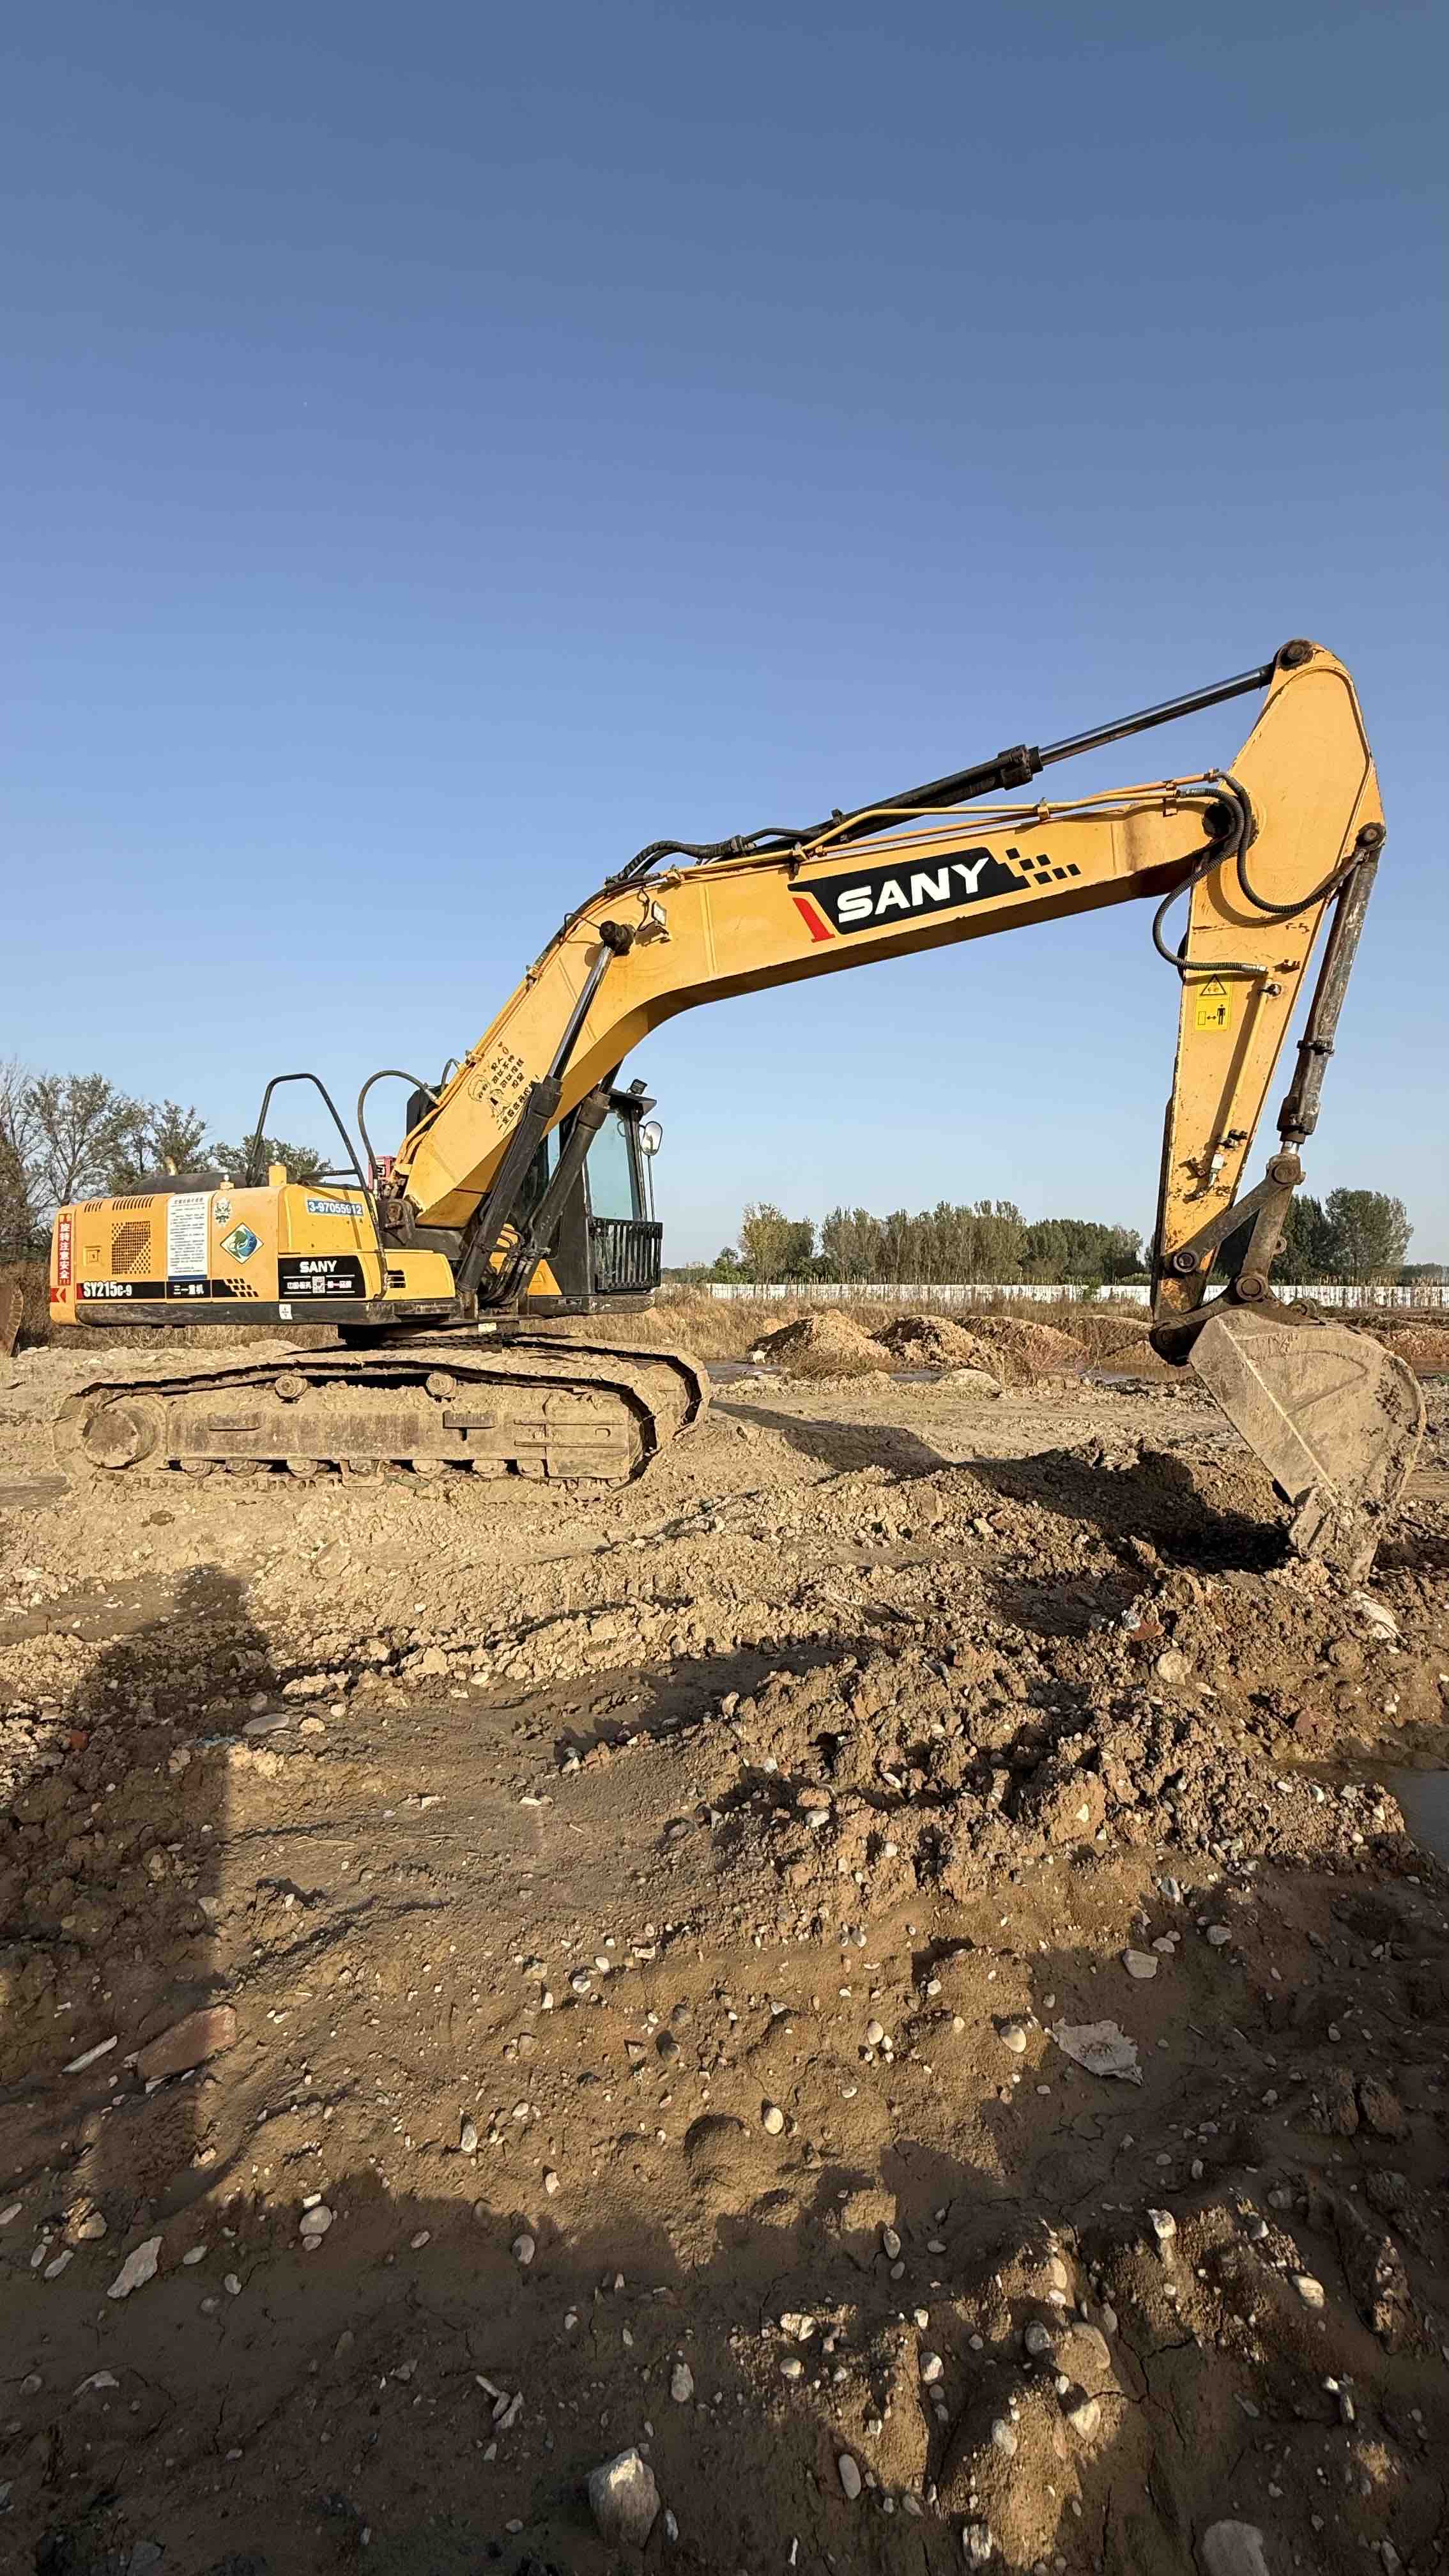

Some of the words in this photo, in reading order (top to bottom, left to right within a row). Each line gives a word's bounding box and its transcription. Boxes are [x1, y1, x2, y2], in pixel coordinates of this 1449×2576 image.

[836, 857, 989, 924] SANY
[299, 1260, 337, 1273] SANY
[173, 1284, 204, 1295] 三一重机
